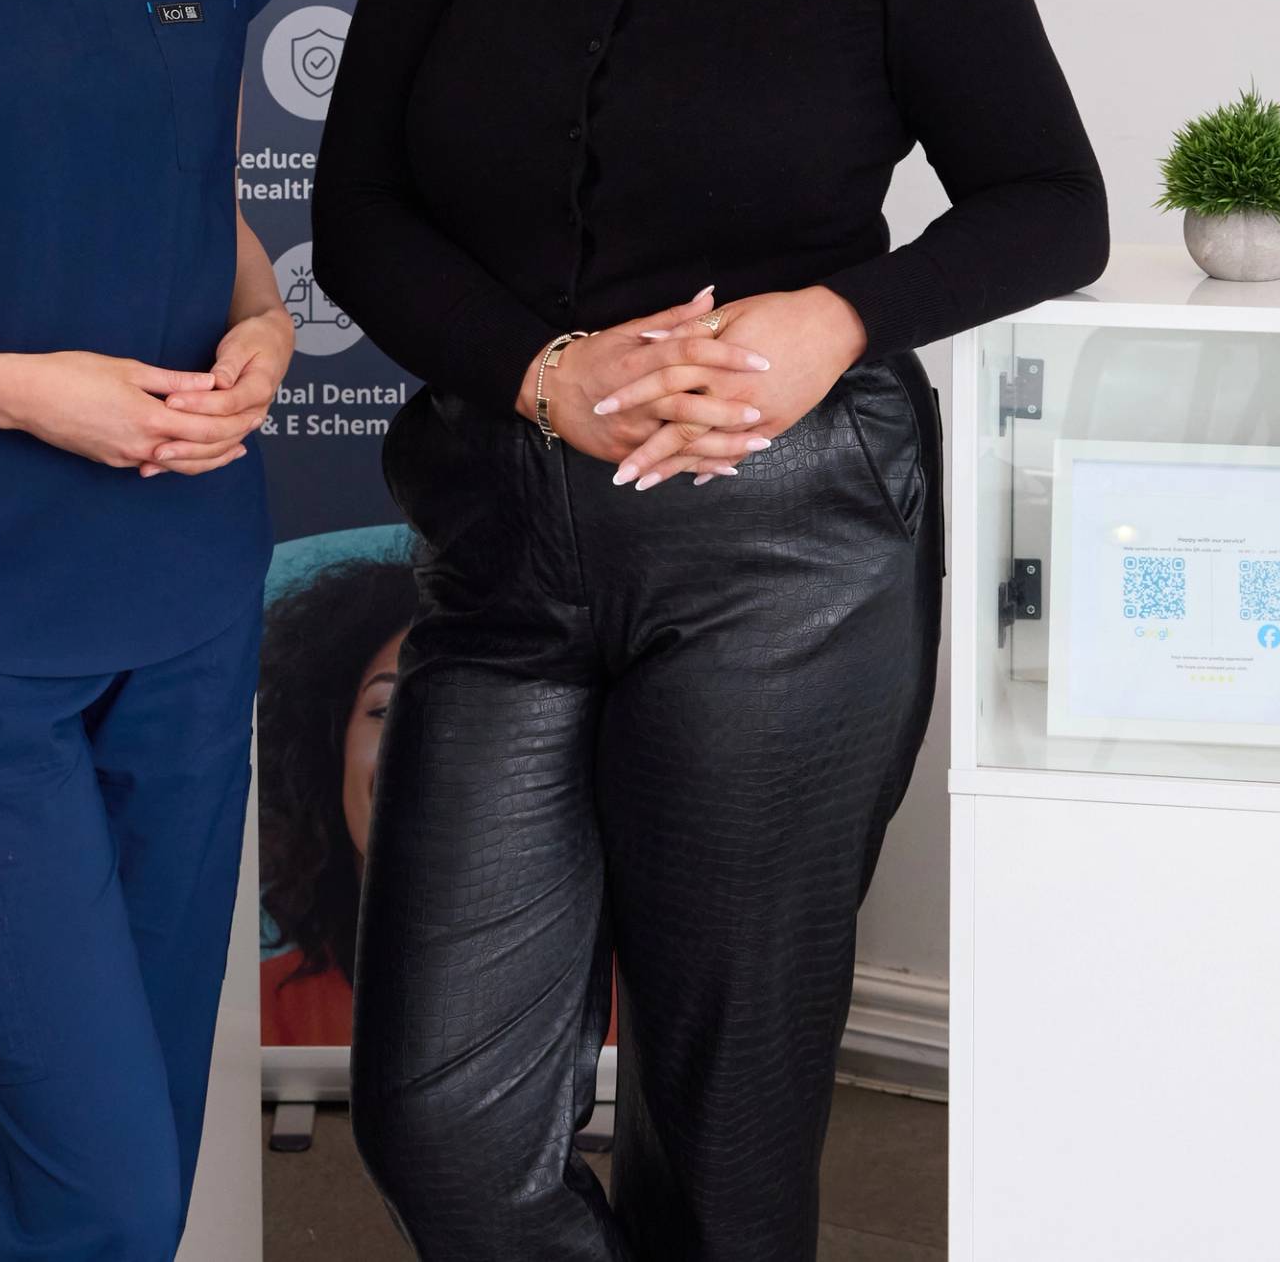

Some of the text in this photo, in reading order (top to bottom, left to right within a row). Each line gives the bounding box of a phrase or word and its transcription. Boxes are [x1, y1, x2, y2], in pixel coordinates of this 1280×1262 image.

[162, 5, 184, 21] koi
[236, 147, 317, 170] educe
[271, 382, 406, 405] bal Dental
[260, 413, 390, 436] & E Schem
